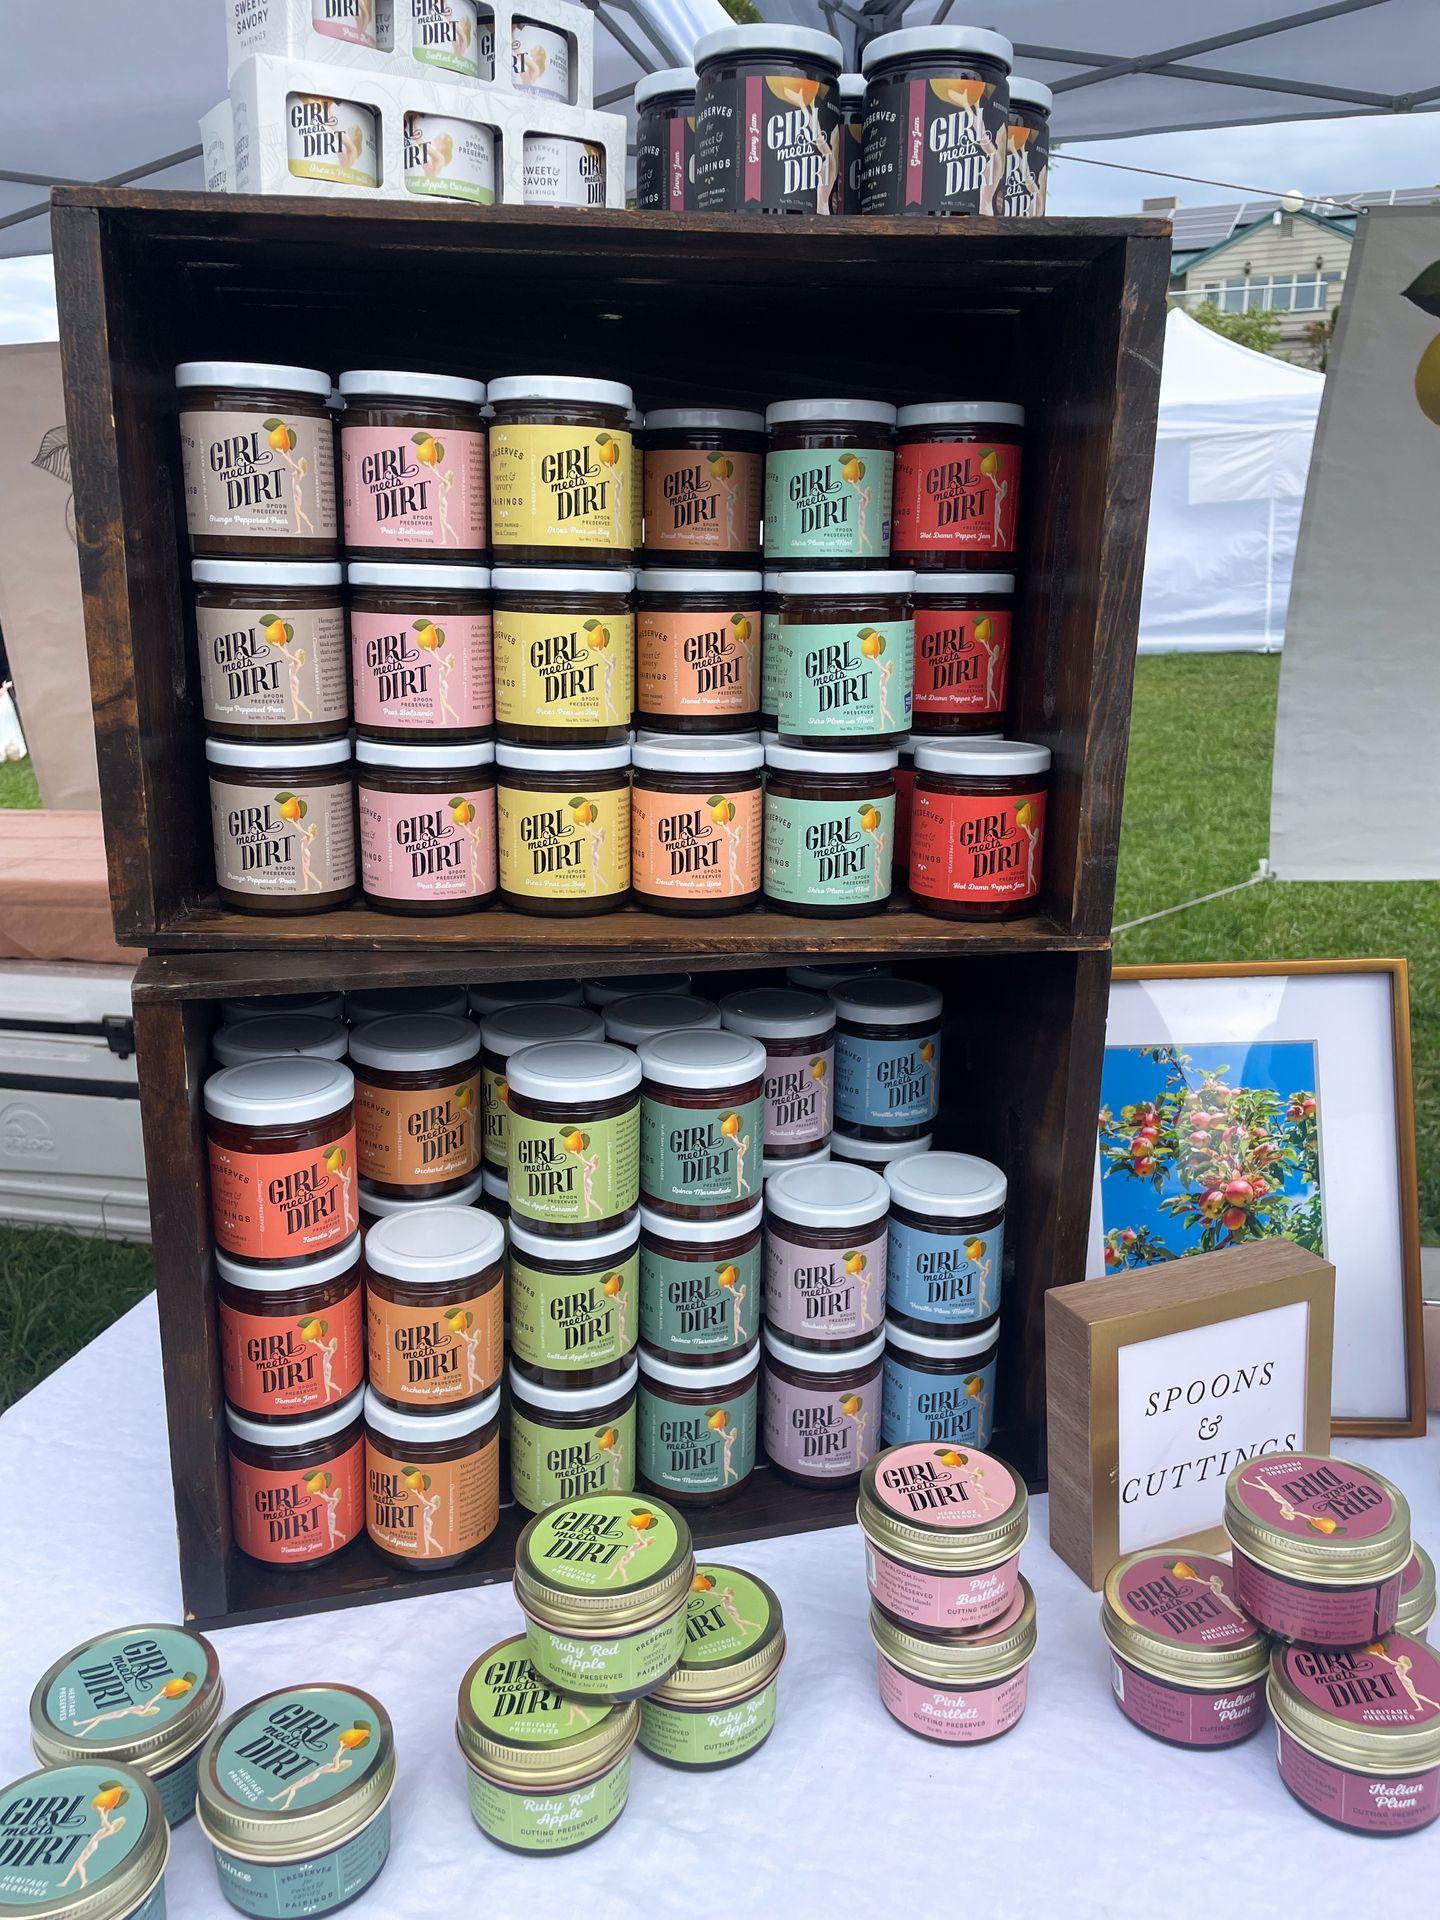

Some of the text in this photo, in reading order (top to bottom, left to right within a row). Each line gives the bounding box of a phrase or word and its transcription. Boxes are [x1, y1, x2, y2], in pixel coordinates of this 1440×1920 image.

[236, 9, 268, 35] SAVORY
[291, 100, 338, 128] GIRL
[767, 108, 828, 150] GIRL
[930, 108, 992, 153] GIRL
[303, 131, 346, 157] DIRT
[458, 146, 489, 162] PRESERVES
[466, 141, 484, 150] SPOON
[749, 113, 760, 163] Ginny Jam
[911, 117, 921, 167] Ginny Jam
[696, 159, 731, 175] PAIRINGS
[784, 155, 830, 195] DIRT
[945, 153, 994, 197] DIRT
[209, 431, 273, 472] GIRL
[362, 446, 419, 485] GIRL
[541, 446, 600, 484] GIRL
[226, 468, 285, 510] DIRT
[663, 465, 711, 499] GIRL
[790, 465, 842, 502] GIRL
[926, 459, 980, 494] GIRL
[376, 480, 431, 522] DIRT
[557, 481, 610, 521] DIRT
[801, 495, 852, 534] DIRT
[938, 488, 990, 527] DIRT
[933, 532, 952, 540] Damn
[954, 533, 976, 542] Pepper
[977, 533, 990, 541] Jam
[214, 628, 270, 665] GIRL
[530, 632, 589, 669] GIRL
[921, 626, 974, 659] GIRL
[805, 641, 862, 679] GIRL
[933, 654, 983, 690] DIRT
[228, 660, 283, 701] DIRT
[818, 672, 872, 713] DIRT
[383, 708, 433, 717] Pear Balsamic
[915, 693, 984, 704] Hot Damn Pepper Jam
[229, 805, 284, 836] GIRL
[396, 810, 454, 844] GIRL
[805, 816, 861, 851] GIRL
[960, 812, 1016, 847] GIRL
[241, 835, 295, 871] DIRT
[411, 839, 464, 877] DIRT
[533, 839, 586, 875] DIRT
[670, 839, 722, 876] DIRT
[818, 845, 869, 883] DIRT
[973, 839, 1024, 878] DIRT
[417, 881, 466, 889] Pear Balsamic
[656, 878, 674, 887] Donut
[953, 882, 1024, 894] Hot Damn Pepper Jam
[877, 1052, 923, 1083] GIRL
[888, 1073, 929, 1109] DIRT
[408, 1100, 461, 1136] GIRL
[776, 1091, 819, 1126] DIRT
[422, 1120, 467, 1164] DIRT
[670, 1124, 724, 1153] GIRL
[415, 1158, 467, 1175] Orchard Apricot
[528, 1166, 577, 1197] DIRT
[683, 1148, 733, 1184] DIRT
[268, 1163, 329, 1204] GIRL
[672, 1186, 731, 1196] Quince Marmalade
[287, 1185, 339, 1235] DIRT
[302, 1226, 340, 1245] Tomato Jam
[916, 1249, 968, 1274] GIRL
[551, 1287, 605, 1320] GIRL
[806, 1287, 854, 1320] DIRT
[928, 1272, 976, 1303] DIRT
[681, 1299, 730, 1334] DIRT
[935, 1306, 952, 1314] Plum
[564, 1308, 614, 1350] DIRT
[670, 1335, 728, 1344] Quince Marmalade
[247, 1331, 306, 1362] GIRL
[262, 1354, 318, 1394] DIRT
[408, 1345, 462, 1383] DIRT
[275, 1394, 318, 1406] Tomato Jam
[401, 1383, 462, 1394] Orchard Apricot
[1145, 1361, 1275, 1417] SPOONS
[804, 1426, 851, 1457] DIRT
[1198, 1415, 1223, 1441] &
[666, 1442, 697, 1451] meets
[671, 1440, 720, 1472] DIRT
[560, 1461, 609, 1500] DIRT
[883, 1462, 951, 1489] GIRL
[908, 1481, 968, 1511] DIRT
[1313, 1486, 1383, 1520] GIRL
[269, 1504, 323, 1542] DIRT
[551, 1512, 623, 1538] GIRL
[543, 1539, 628, 1564] DIRT
[898, 1582, 934, 1600] PRESERVED
[956, 1582, 1006, 1606] Bartlett
[1127, 1576, 1193, 1611] GIRL
[1162, 1593, 1222, 1634] DIRT
[1200, 1623, 1237, 1636] HERITAGE
[550, 1635, 620, 1658] Ruby Red
[635, 1628, 673, 1652] PRESERVES
[1202, 1628, 1245, 1640] PRESERVES
[123, 1640, 173, 1692] GIRL
[561, 1654, 606, 1672] Apple
[637, 1655, 672, 1678] PAIRINGS
[78, 1663, 134, 1710] DIRT
[492, 1680, 539, 1693] meets
[933, 1694, 966, 1710] Pink
[1214, 1692, 1256, 1710] Italian
[1325, 1672, 1398, 1708] DIRT
[269, 1703, 340, 1752] GIRL
[707, 1696, 766, 1727] Ruby Red
[720, 1714, 757, 1738] Apple
[921, 1702, 979, 1720] Bartlett
[235, 1735, 319, 1780] DIRT
[228, 1771, 258, 1802] PRESERVES
[237, 1768, 265, 1795] HERITAGE
[1369, 1784, 1424, 1796] Italian
[1, 1795, 87, 1828] GIRL
[523, 1786, 597, 1815] Ruby Red
[537, 1808, 584, 1828] Apple
